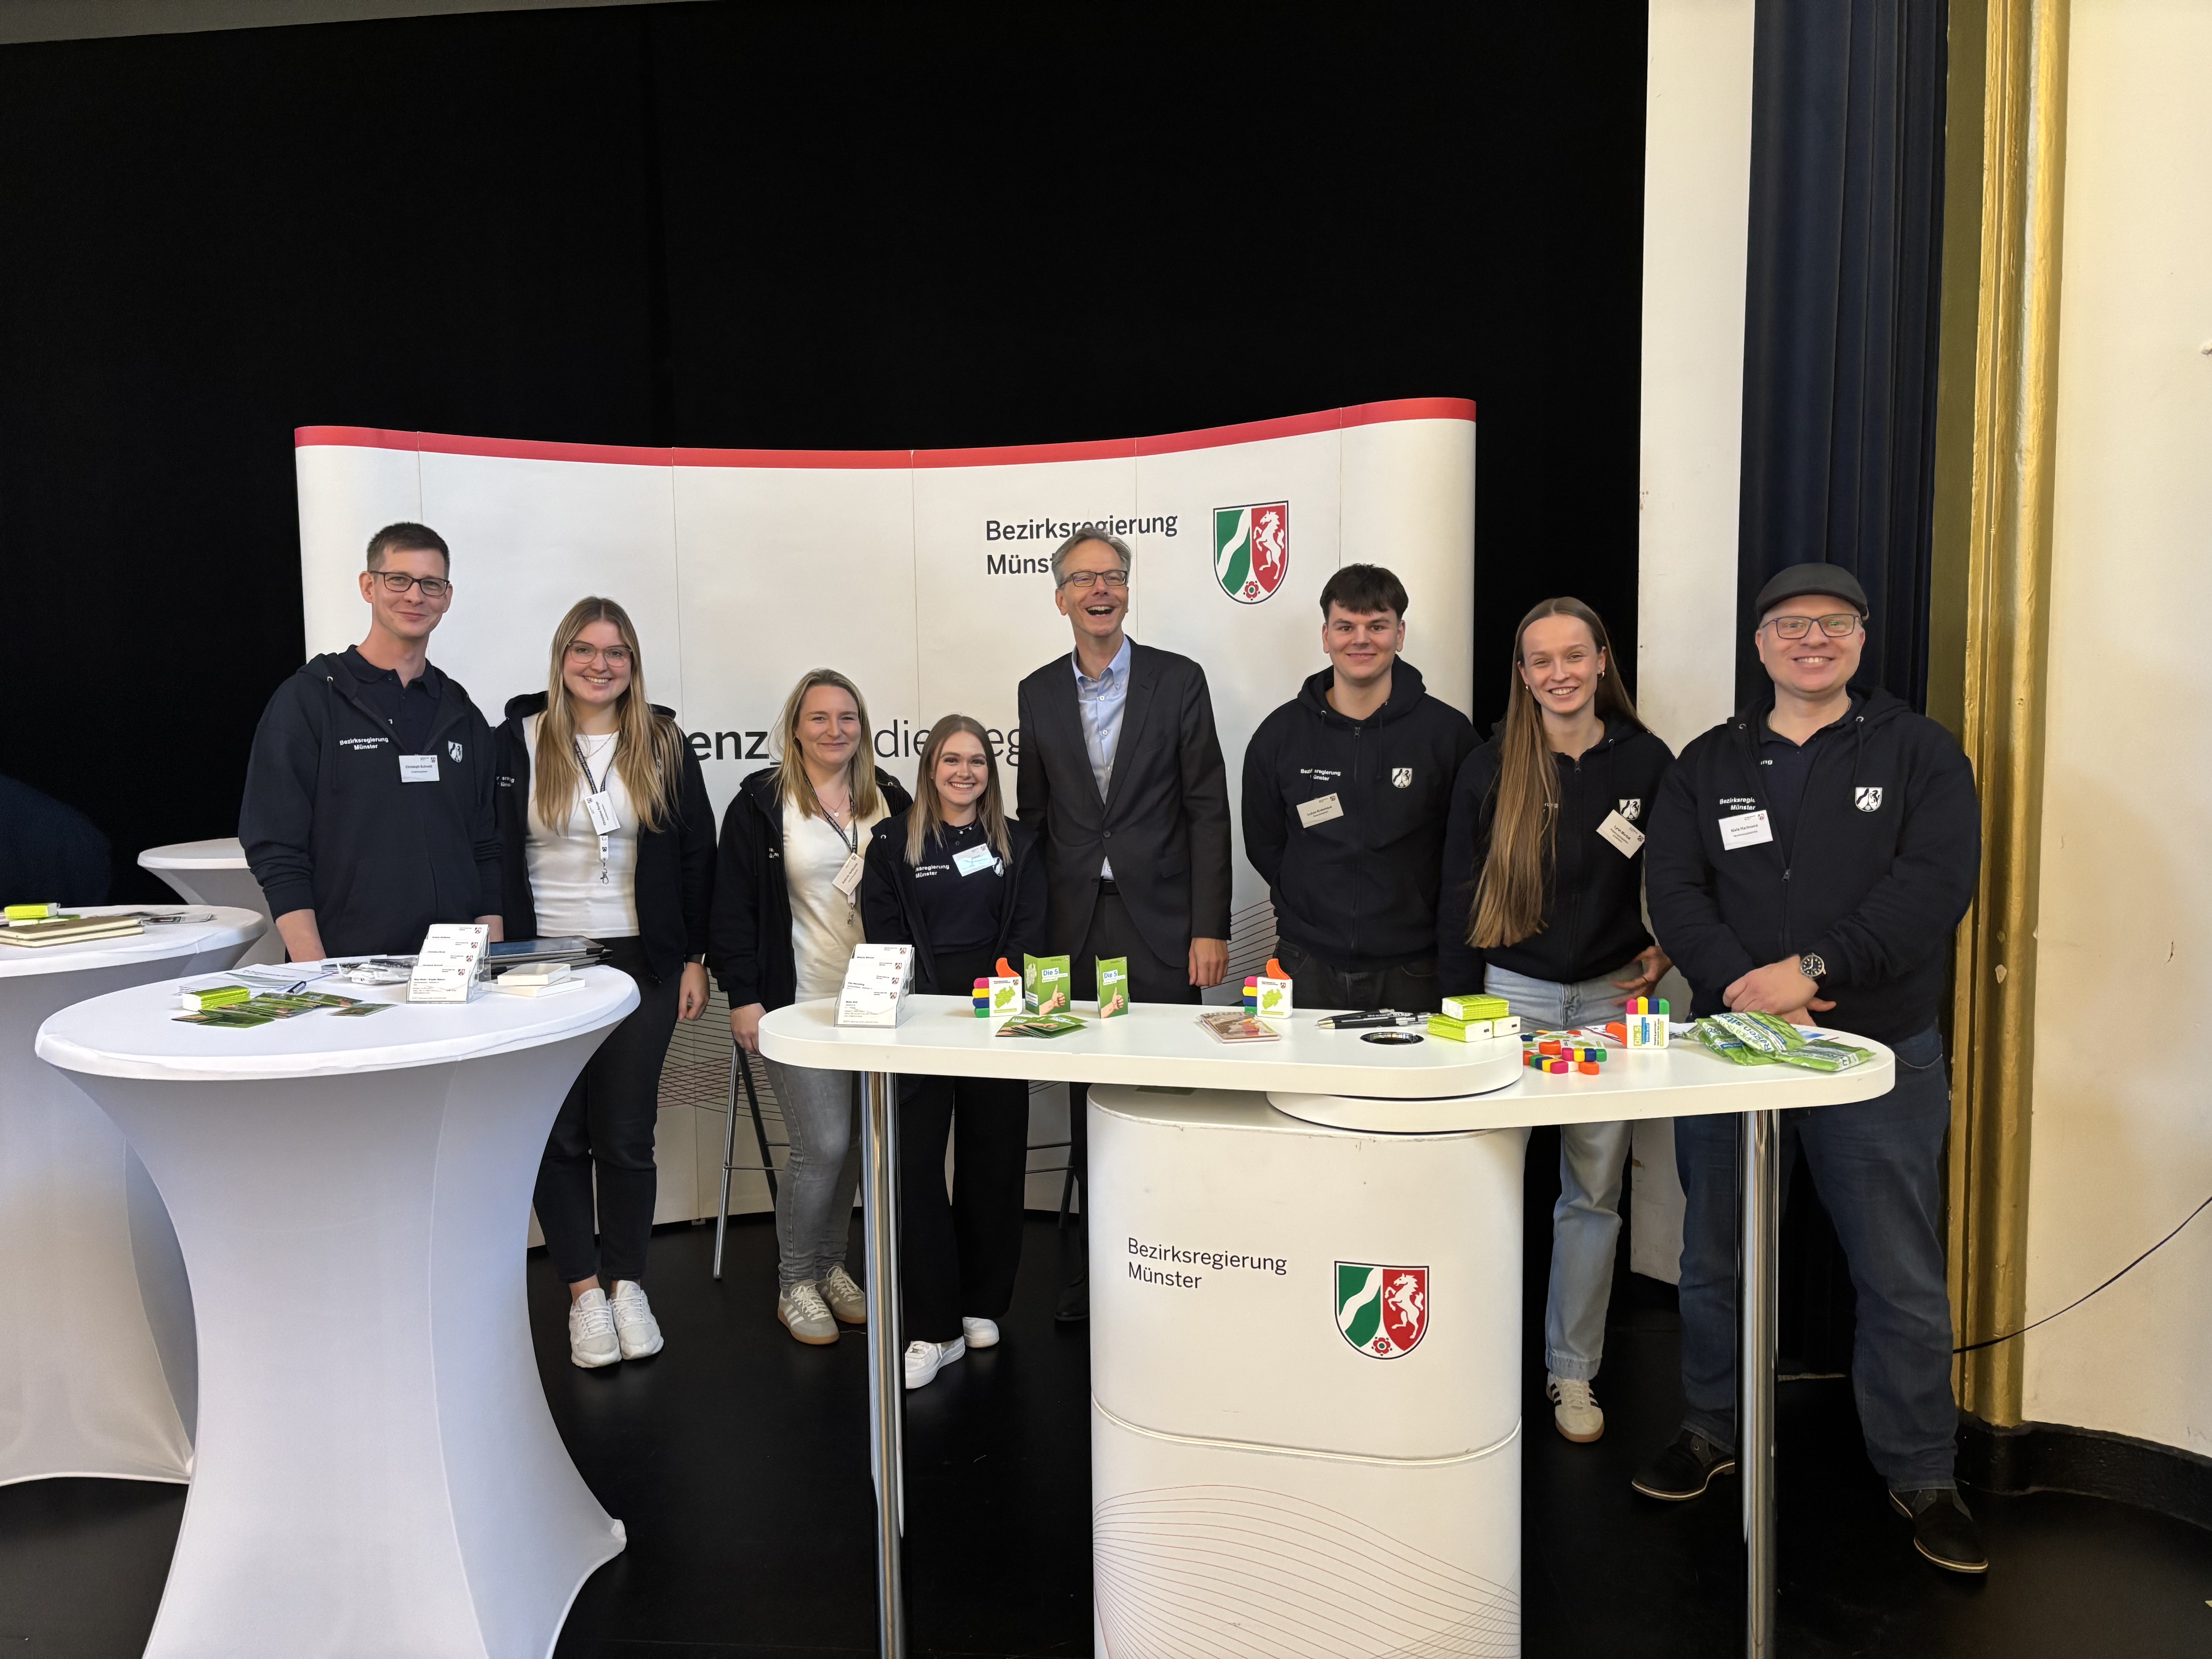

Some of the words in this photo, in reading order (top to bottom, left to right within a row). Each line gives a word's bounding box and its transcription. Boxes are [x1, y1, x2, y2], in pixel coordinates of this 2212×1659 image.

[987, 553, 1055, 575] Müns
[339, 737, 389, 745] Bezirksregierung
[1128, 1237, 1287, 1275] Bezirksregierung
[1129, 1261, 1202, 1289] Münster
